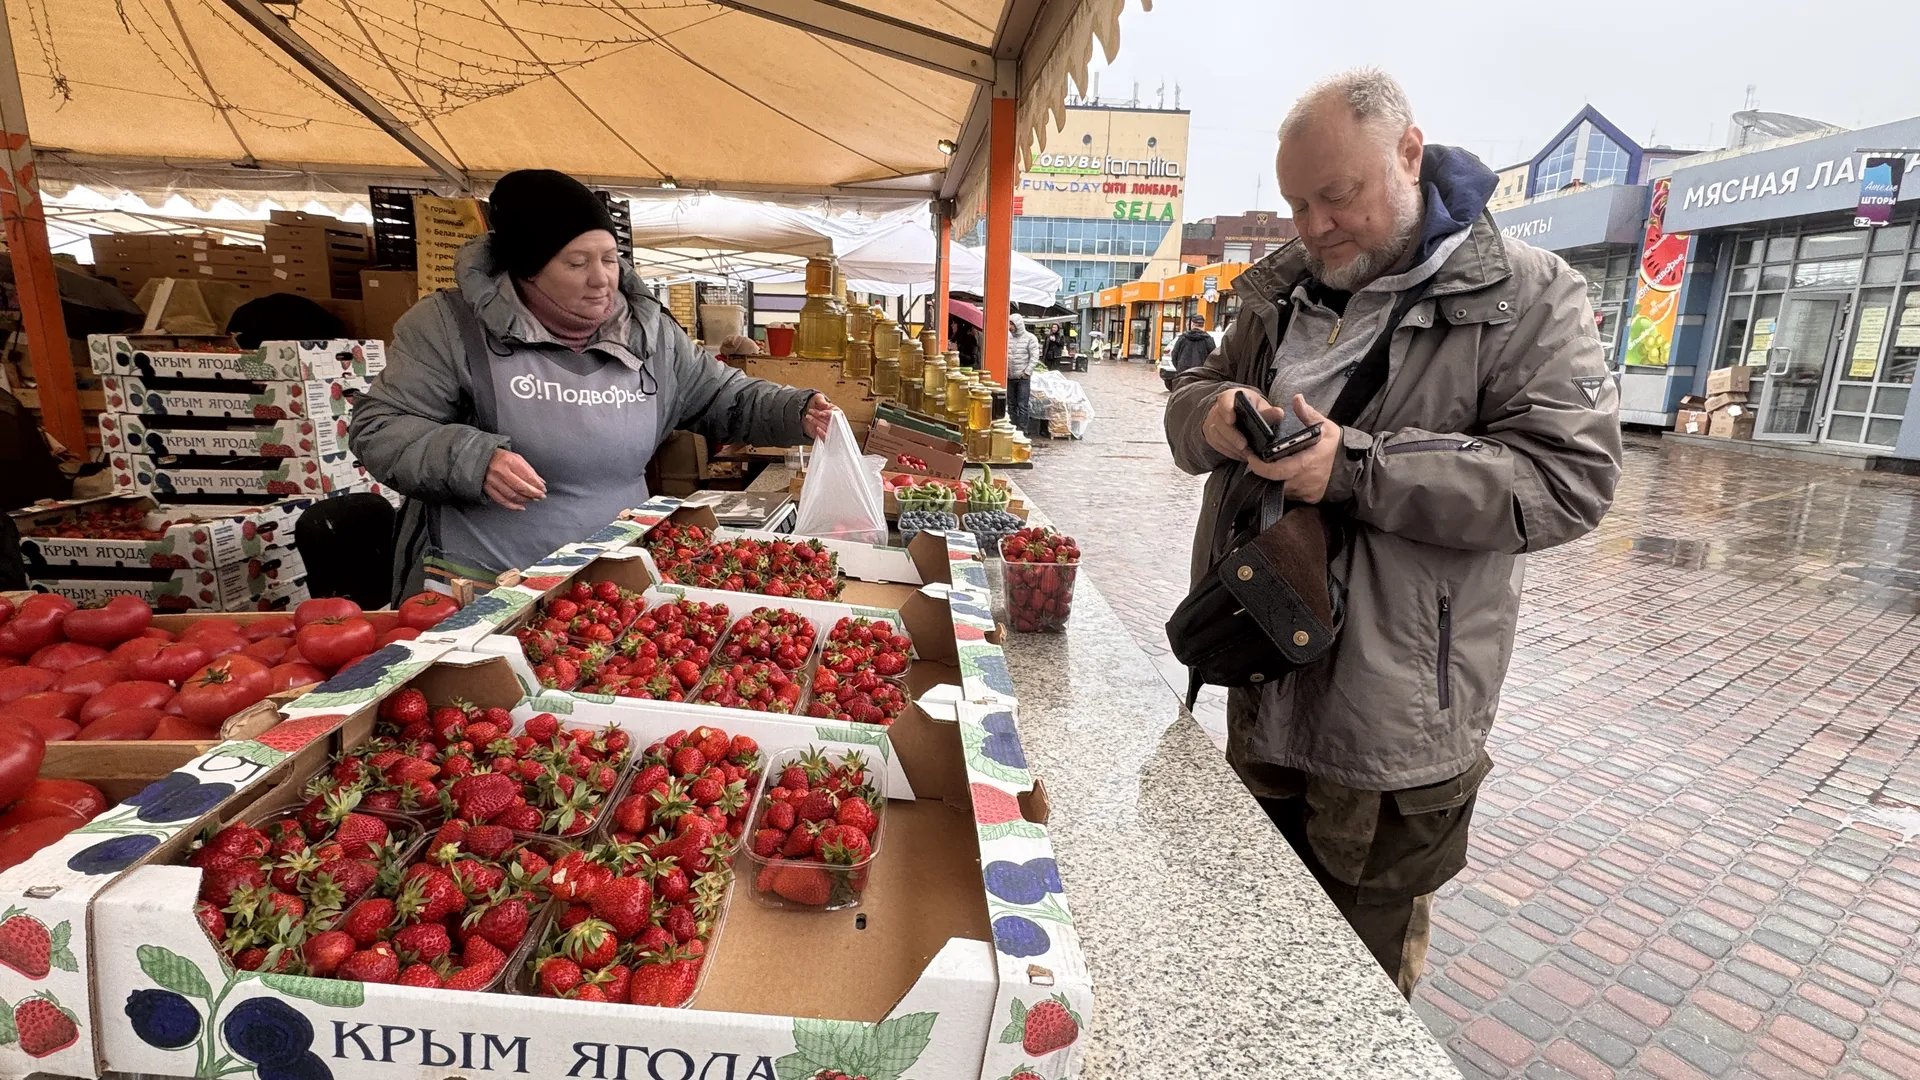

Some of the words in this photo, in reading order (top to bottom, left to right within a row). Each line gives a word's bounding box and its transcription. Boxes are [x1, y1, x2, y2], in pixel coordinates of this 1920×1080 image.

[1040, 154, 1100, 169] ОБУВЬ
[1105, 155, 1180, 176] familia
[1022, 179, 1054, 191] FUN
[1070, 181, 1100, 192] DAY
[1682, 166, 1800, 211] МЯСНАЯ
[1806, 147, 1920, 190] ЛАА
[1102, 181, 1126, 194] СИТИ
[1131, 183, 1178, 197] ЛОМБАРД
[1864, 181, 1899, 192] Ателье
[1861, 196, 1896, 206] ШТОРЫ
[430, 205, 457, 215] горный
[1113, 200, 1174, 220] SELA
[1501, 217, 1552, 239] ФРУКТЫ
[1854, 218, 1870, 226] 9-2
[434, 228, 455, 237] Белая
[434, 252, 454, 261] греч
[434, 264, 454, 272] донн
[435, 276, 456, 284] цвето
[152, 356, 192, 368] КРЫМ
[198, 358, 241, 371] ЯГОДА
[166, 396, 204, 408] КРЫМ
[209, 398, 248, 410] ЯГОДА
[165, 436, 206, 448] КРЫМ
[212, 437, 257, 449] ЯГОДА
[174, 476, 213, 487] КРЫМ
[220, 476, 263, 488] ЯГОДА
[43, 544, 88, 557] КРЫМ
[96, 546, 146, 560] ЯГОДА
[329, 1020, 531, 1074] КРЫМ
[566, 1041, 779, 1080] ЯГОДА
